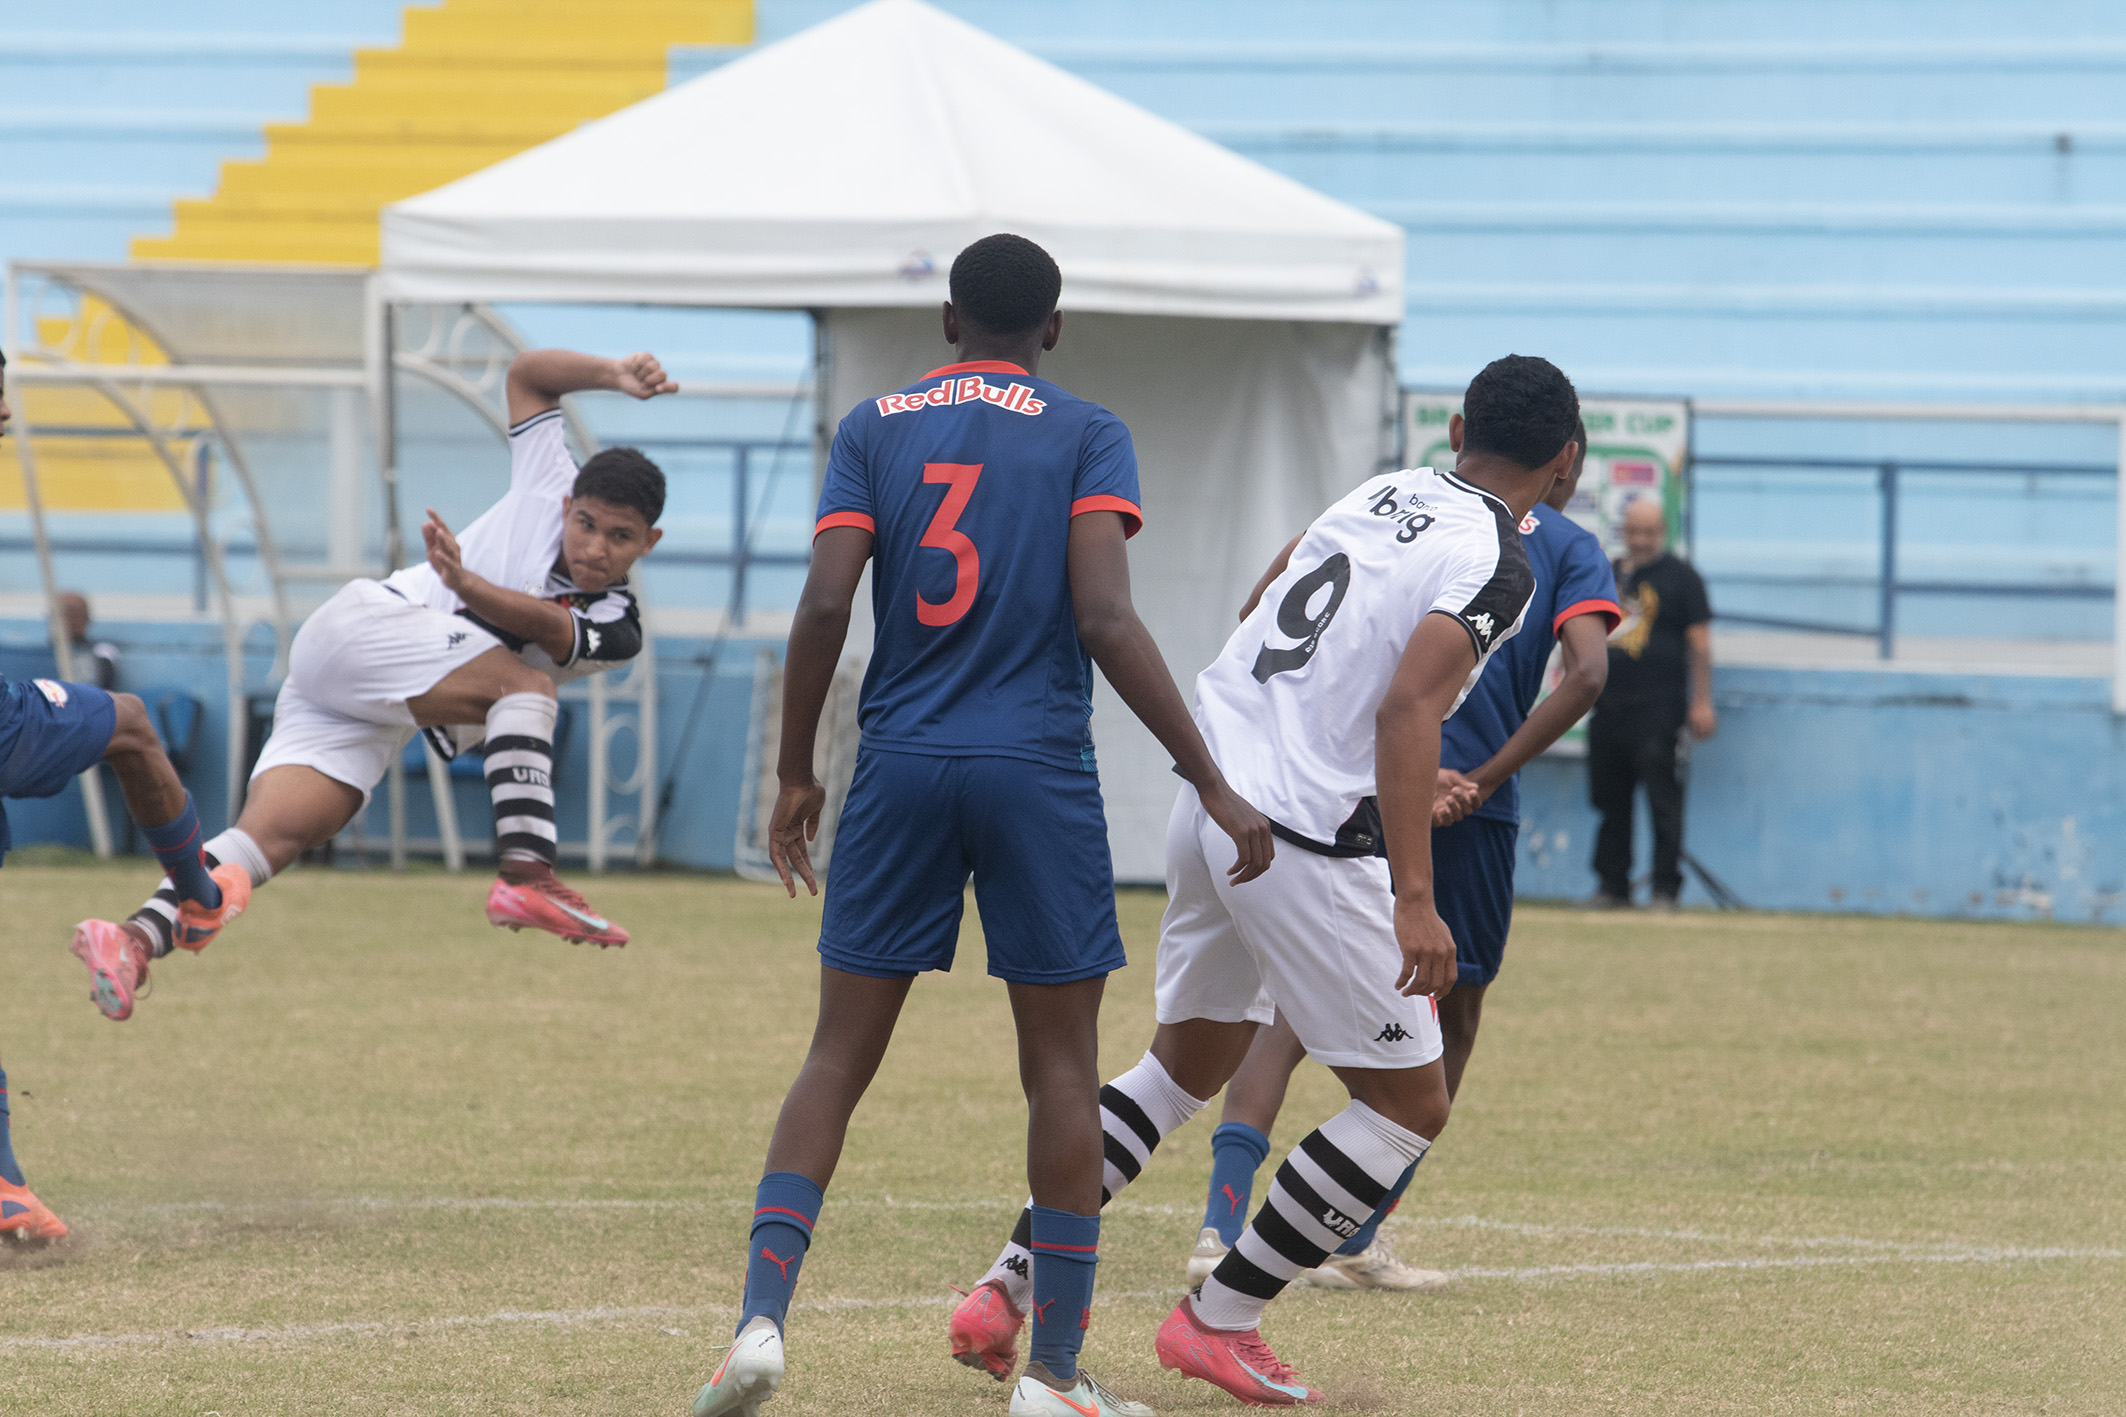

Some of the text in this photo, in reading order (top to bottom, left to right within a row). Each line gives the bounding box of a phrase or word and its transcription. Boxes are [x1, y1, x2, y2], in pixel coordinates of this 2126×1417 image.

[877, 376, 1046, 416] Red Bulls
[917, 463, 984, 627] 3
[1251, 552, 1350, 684] 9
